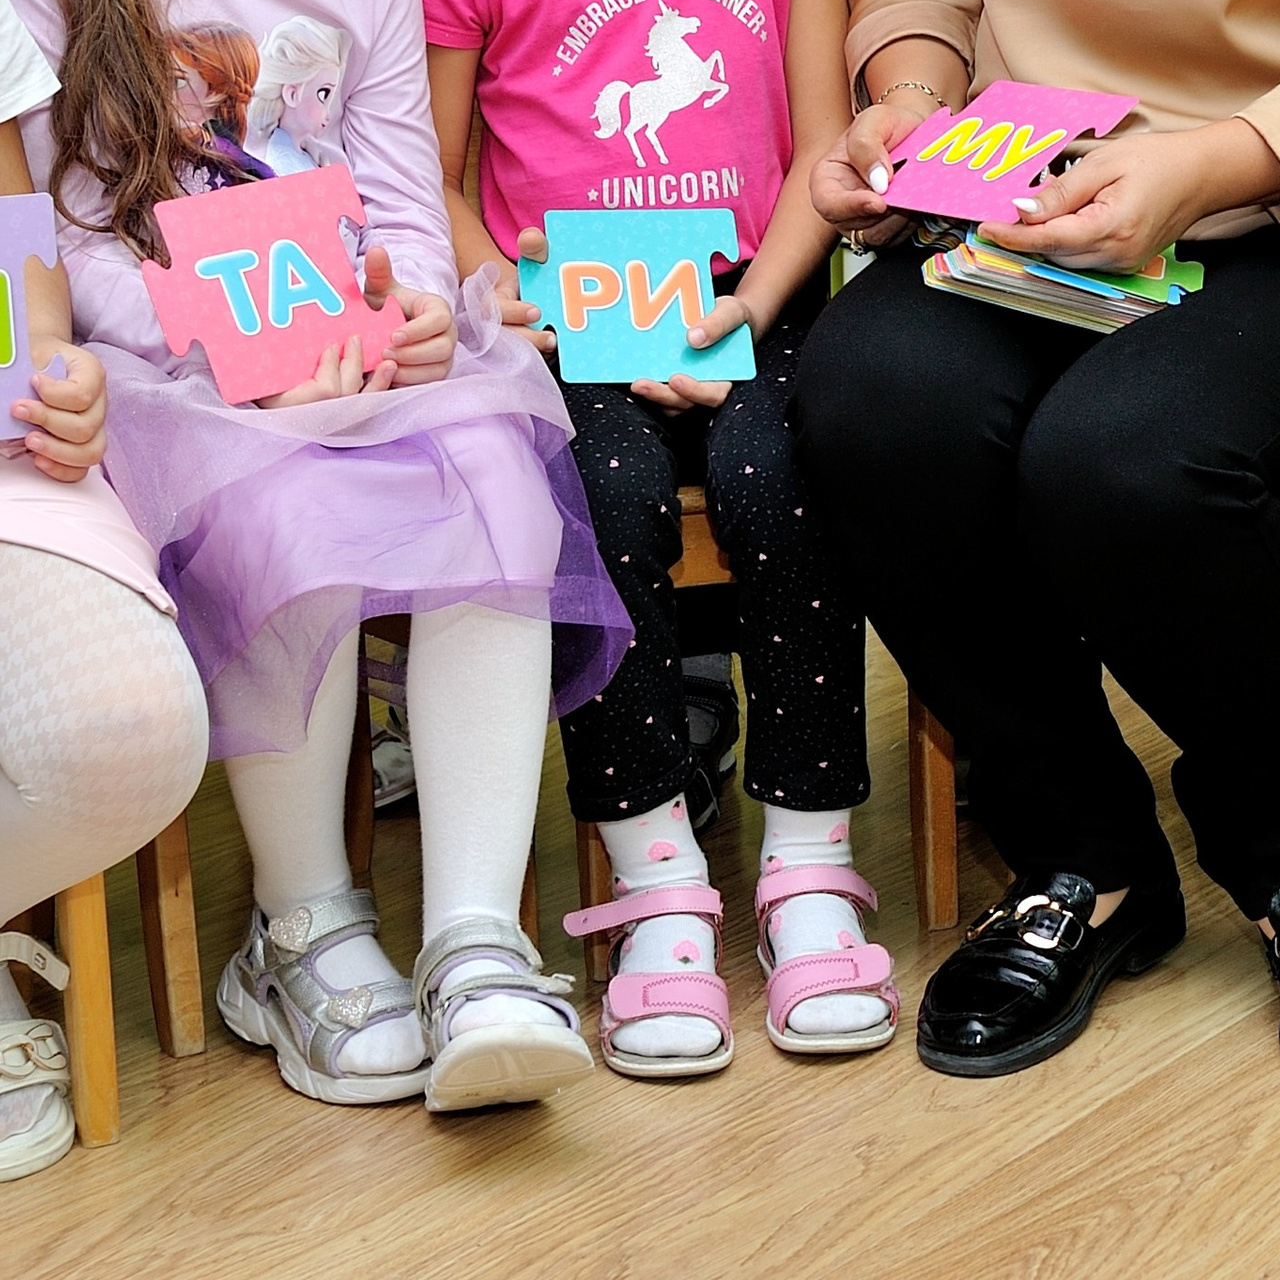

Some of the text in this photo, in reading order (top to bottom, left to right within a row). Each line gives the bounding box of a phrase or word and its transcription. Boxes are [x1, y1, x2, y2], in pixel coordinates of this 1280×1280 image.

[916, 116, 1068, 182] МУ
[602, 166, 740, 209] UNICORN
[195, 239, 345, 336] ТА
[558, 258, 705, 332] РИ
